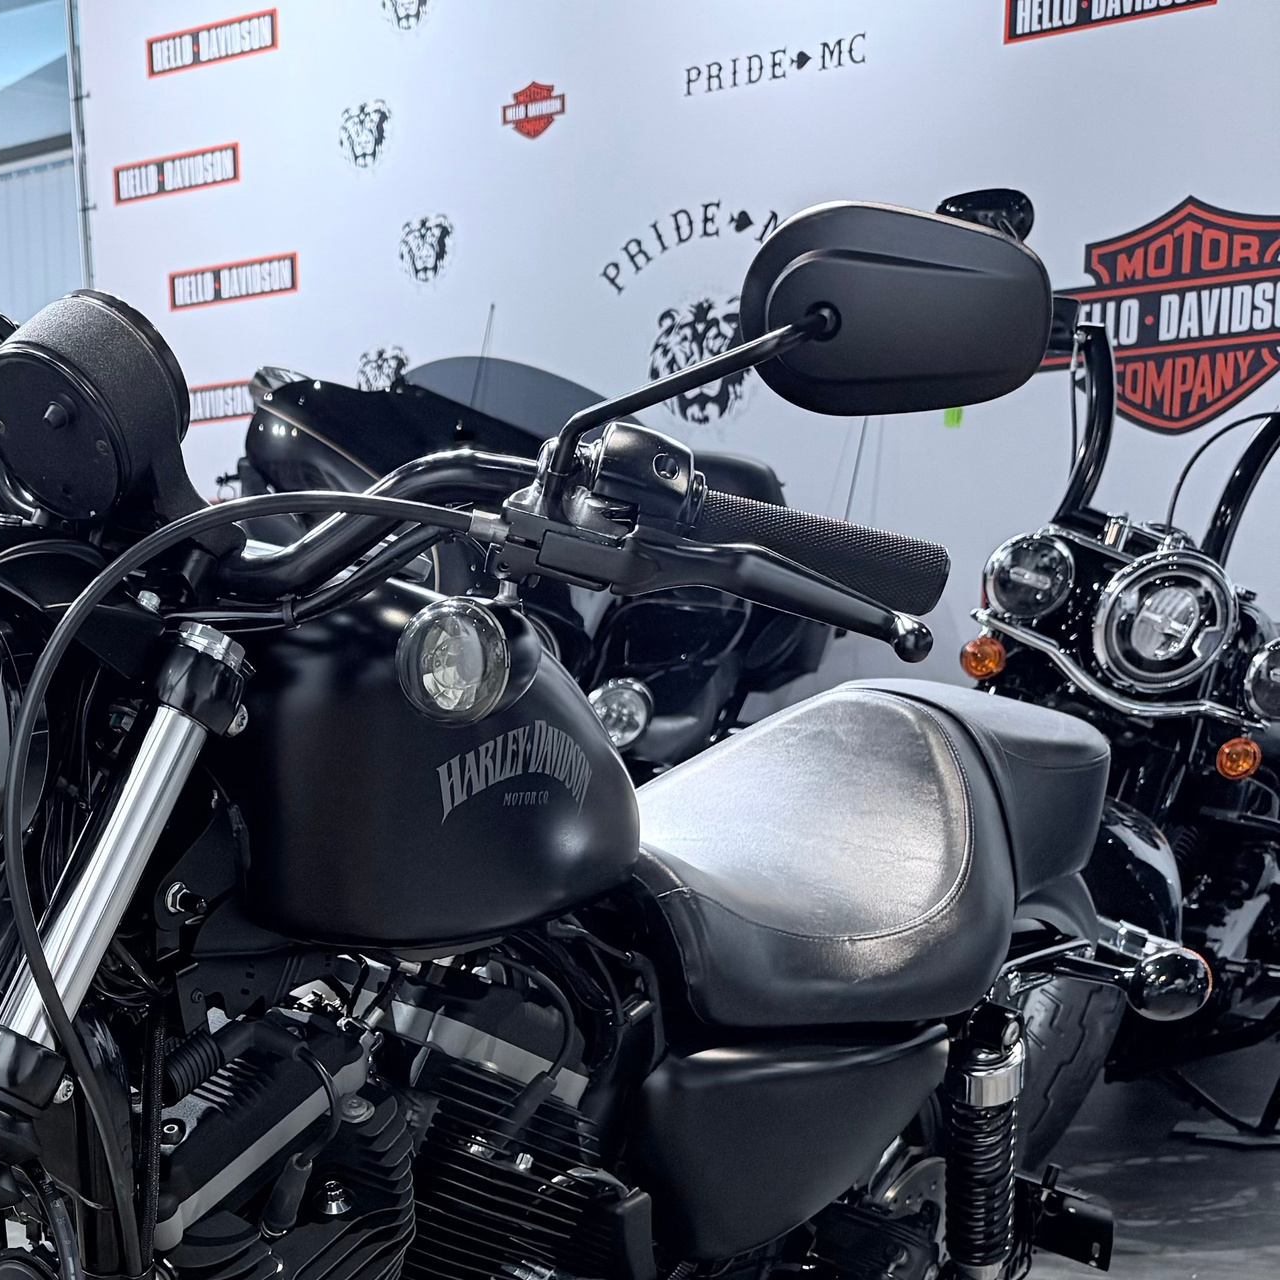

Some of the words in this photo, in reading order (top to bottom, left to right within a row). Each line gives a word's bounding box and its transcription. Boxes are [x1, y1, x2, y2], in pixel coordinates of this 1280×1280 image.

[152, 34, 193, 73] HELLO
[199, 15, 272, 62] DAVIDSON
[684, 46, 787, 97] PRIDE
[818, 37, 866, 71] MC
[118, 164, 158, 200] HELLO
[163, 148, 234, 191] DAVIDSON
[599, 199, 721, 295] PRIDE
[1116, 219, 1260, 283] MOTOR
[174, 271, 214, 306] HELLO
[220, 258, 292, 299] DAVIDSON
[1158, 281, 1280, 342] DAVIDS
[1116, 348, 1255, 418] OMPANY
[436, 725, 530, 826] HARLEY
[527, 720, 593, 819] DAVIDSON
[503, 791, 537, 806] MOTOR
